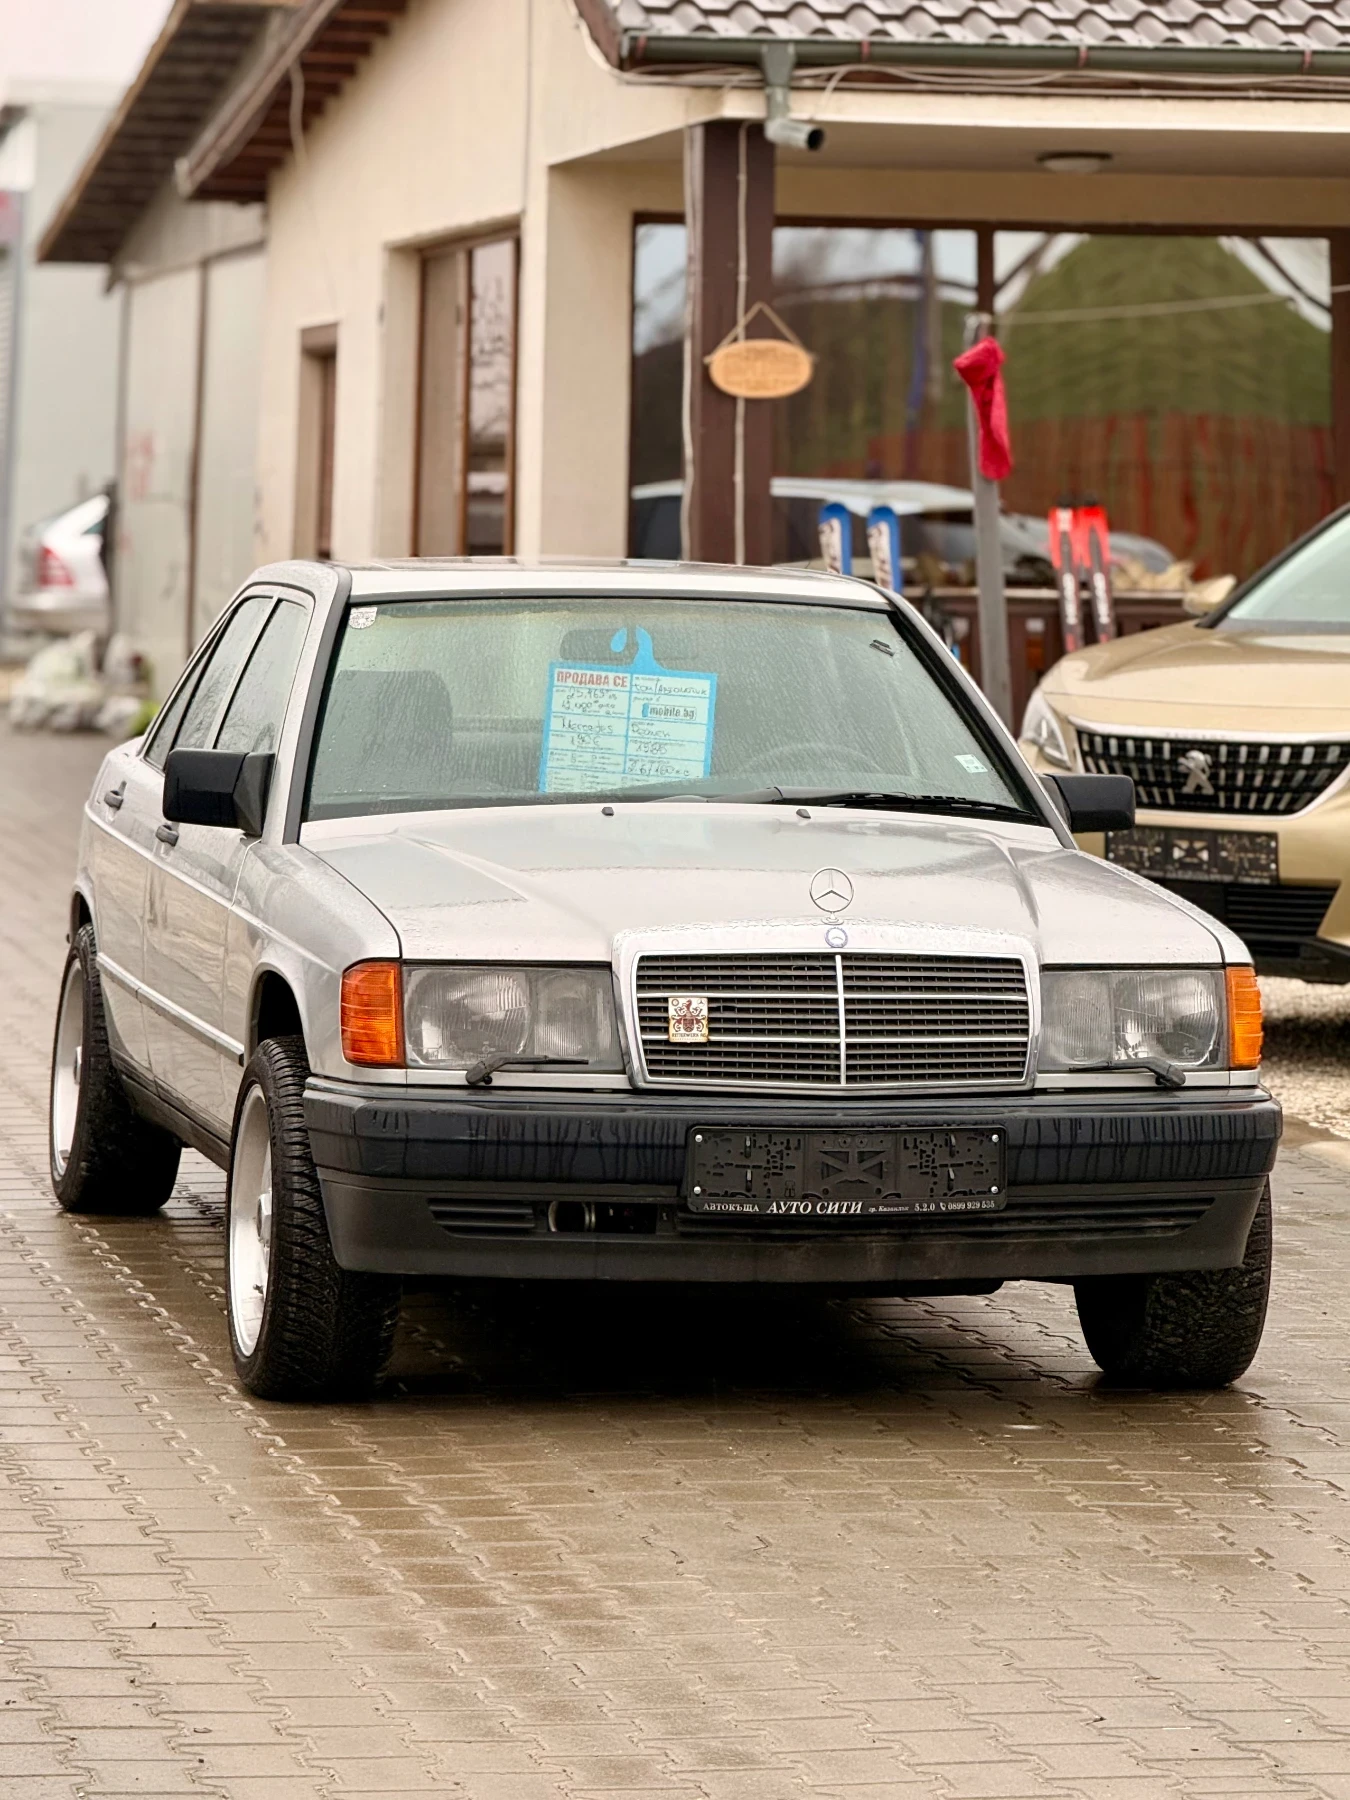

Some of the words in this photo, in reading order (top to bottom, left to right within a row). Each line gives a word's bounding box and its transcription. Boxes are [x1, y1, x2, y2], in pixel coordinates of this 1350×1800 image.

[556, 671, 609, 686] ПРОДАВА
[613, 675, 628, 687] СЕ
[649, 705, 695, 720] mobile.bg
[702, 1202, 760, 1213] АВТОКЪЩА
[766, 1201, 813, 1214] АУТО
[816, 1201, 864, 1214] СИТИ
[947, 1202, 966, 1210] 0899
[966, 1201, 981, 1209] 929
